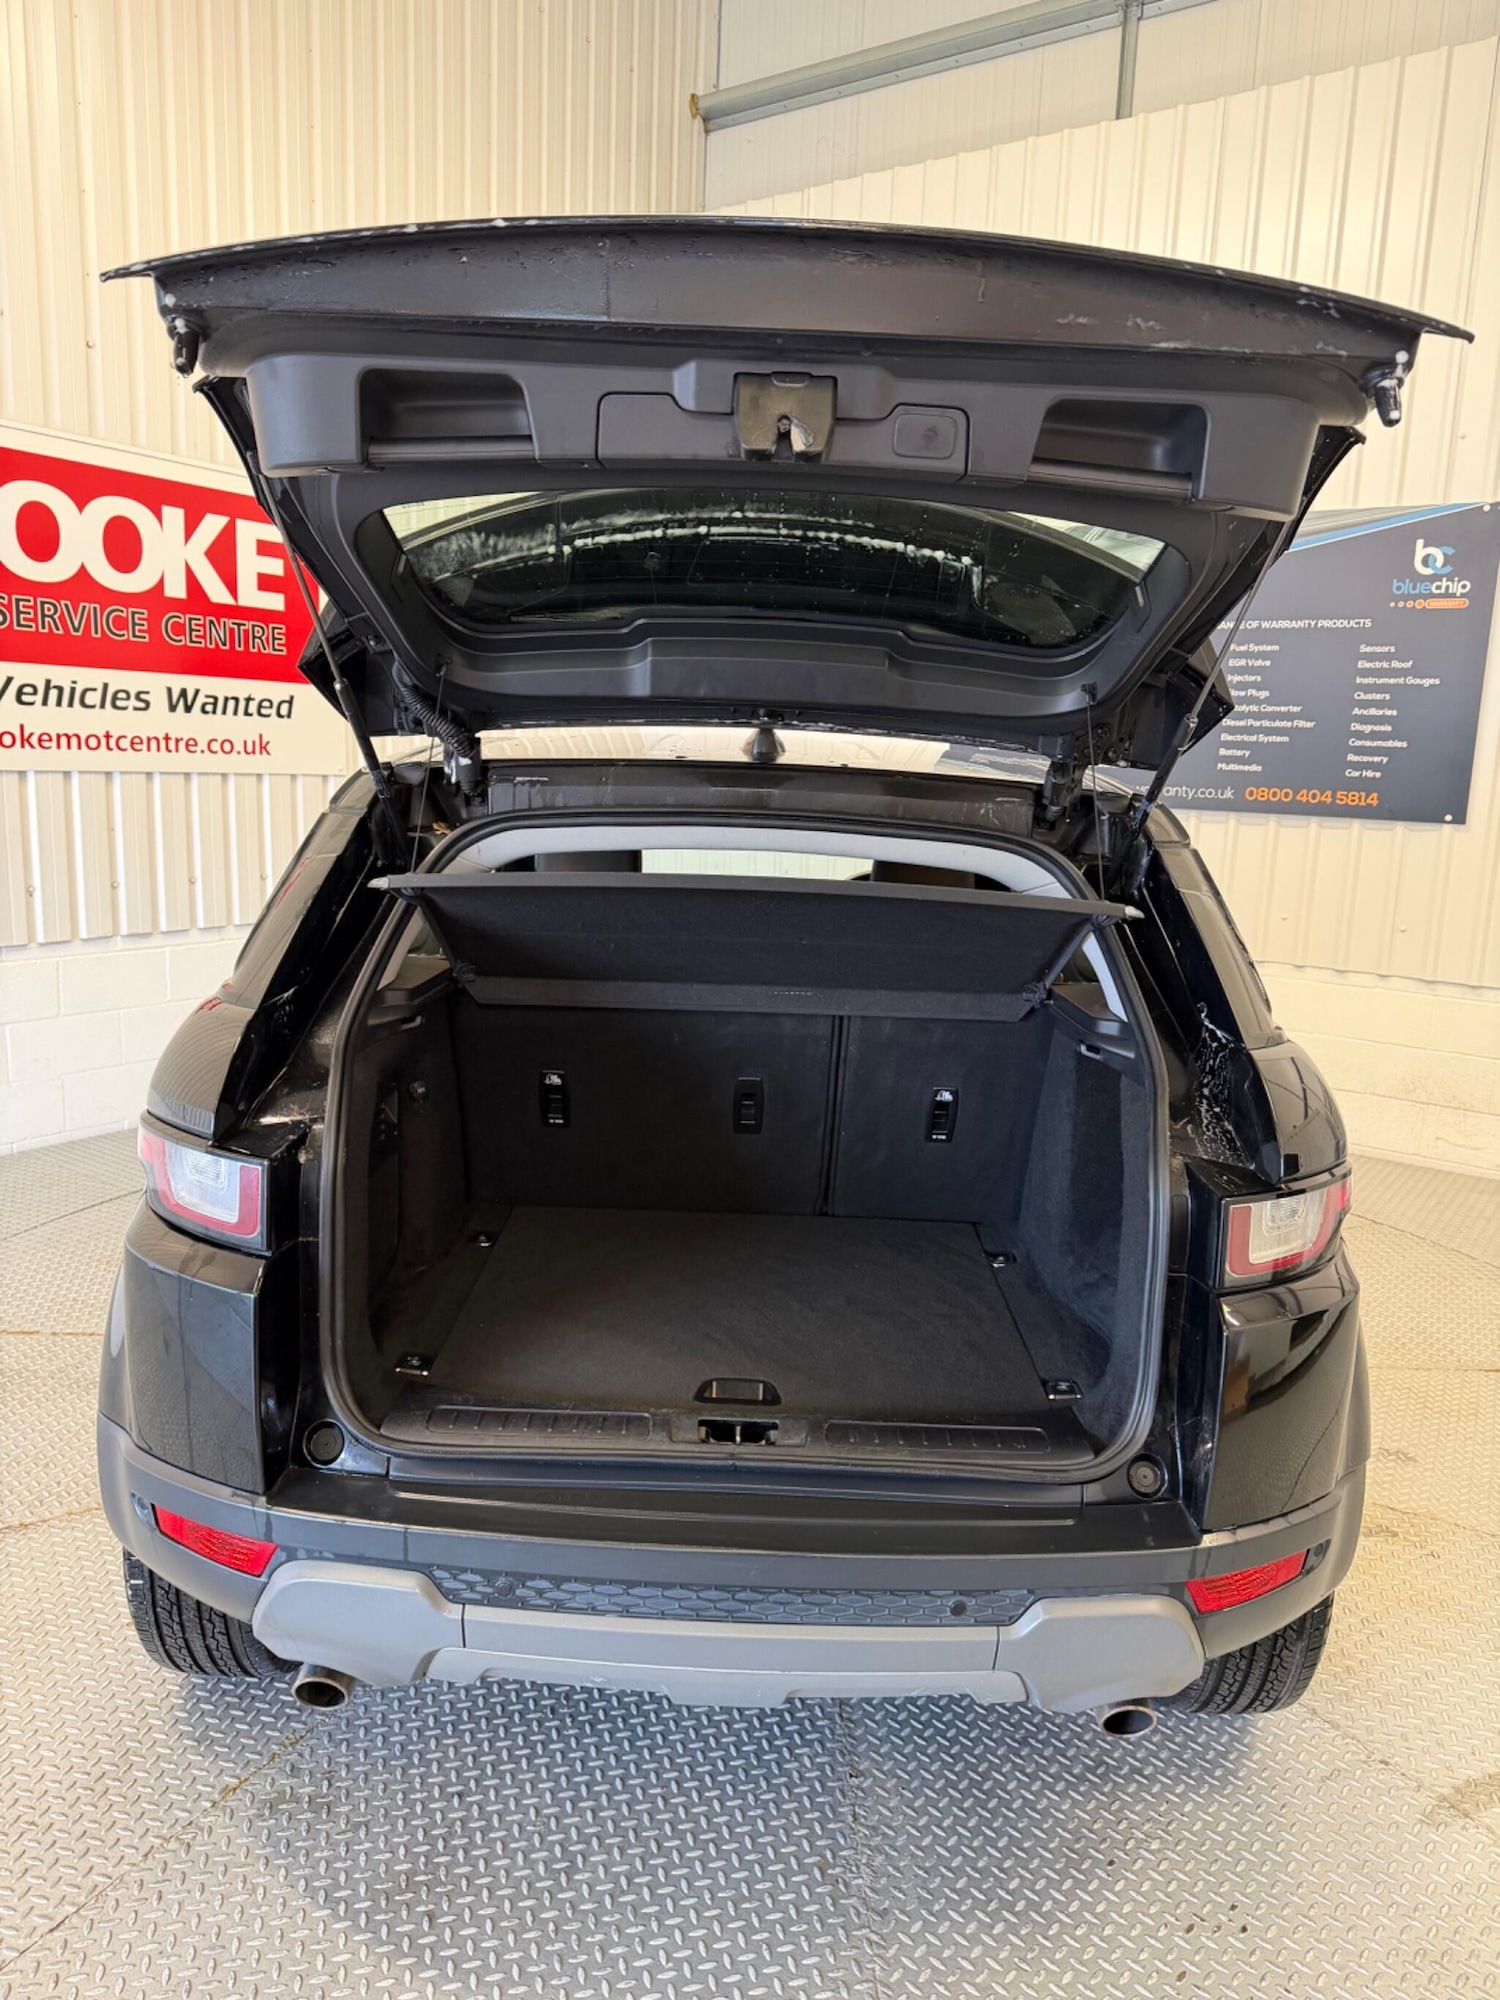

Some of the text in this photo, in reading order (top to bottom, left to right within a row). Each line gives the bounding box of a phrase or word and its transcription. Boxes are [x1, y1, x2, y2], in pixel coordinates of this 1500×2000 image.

[1392, 577, 1471, 597] bluechip
[1217, 618, 1372, 630] ANE OF WARRANTY PRODUCTS
[162, 613, 287, 656] CENTRE
[1230, 643, 1280, 653] Fuel System
[1359, 643, 1396, 653] Sensors
[1228, 658, 1271, 667] EGR Valve
[1357, 660, 1414, 668] Electric Roof
[1227, 674, 1262, 684] Injectors
[1355, 676, 1441, 688] Instrument Gauges
[1229, 688, 1270, 699] low Plugs
[1353, 691, 1391, 701] Clusters
[165, 686, 294, 719] Wanted
[1234, 703, 1303, 713] talytic Converter
[1351, 707, 1398, 716] Ancillaries
[1222, 719, 1317, 730] Diesel Particulate Filter
[1350, 722, 1393, 733] Diagnosis
[1220, 733, 1290, 744] Electrical System
[1348, 738, 1409, 748] Consumables
[1219, 748, 1251, 758] Battery
[1346, 753, 1389, 765] Recovery
[1217, 763, 1263, 773] Multimedia
[1345, 769, 1382, 778] Car Hire
[1150, 785, 1379, 807] anty.co.uk 0800 404 5814
